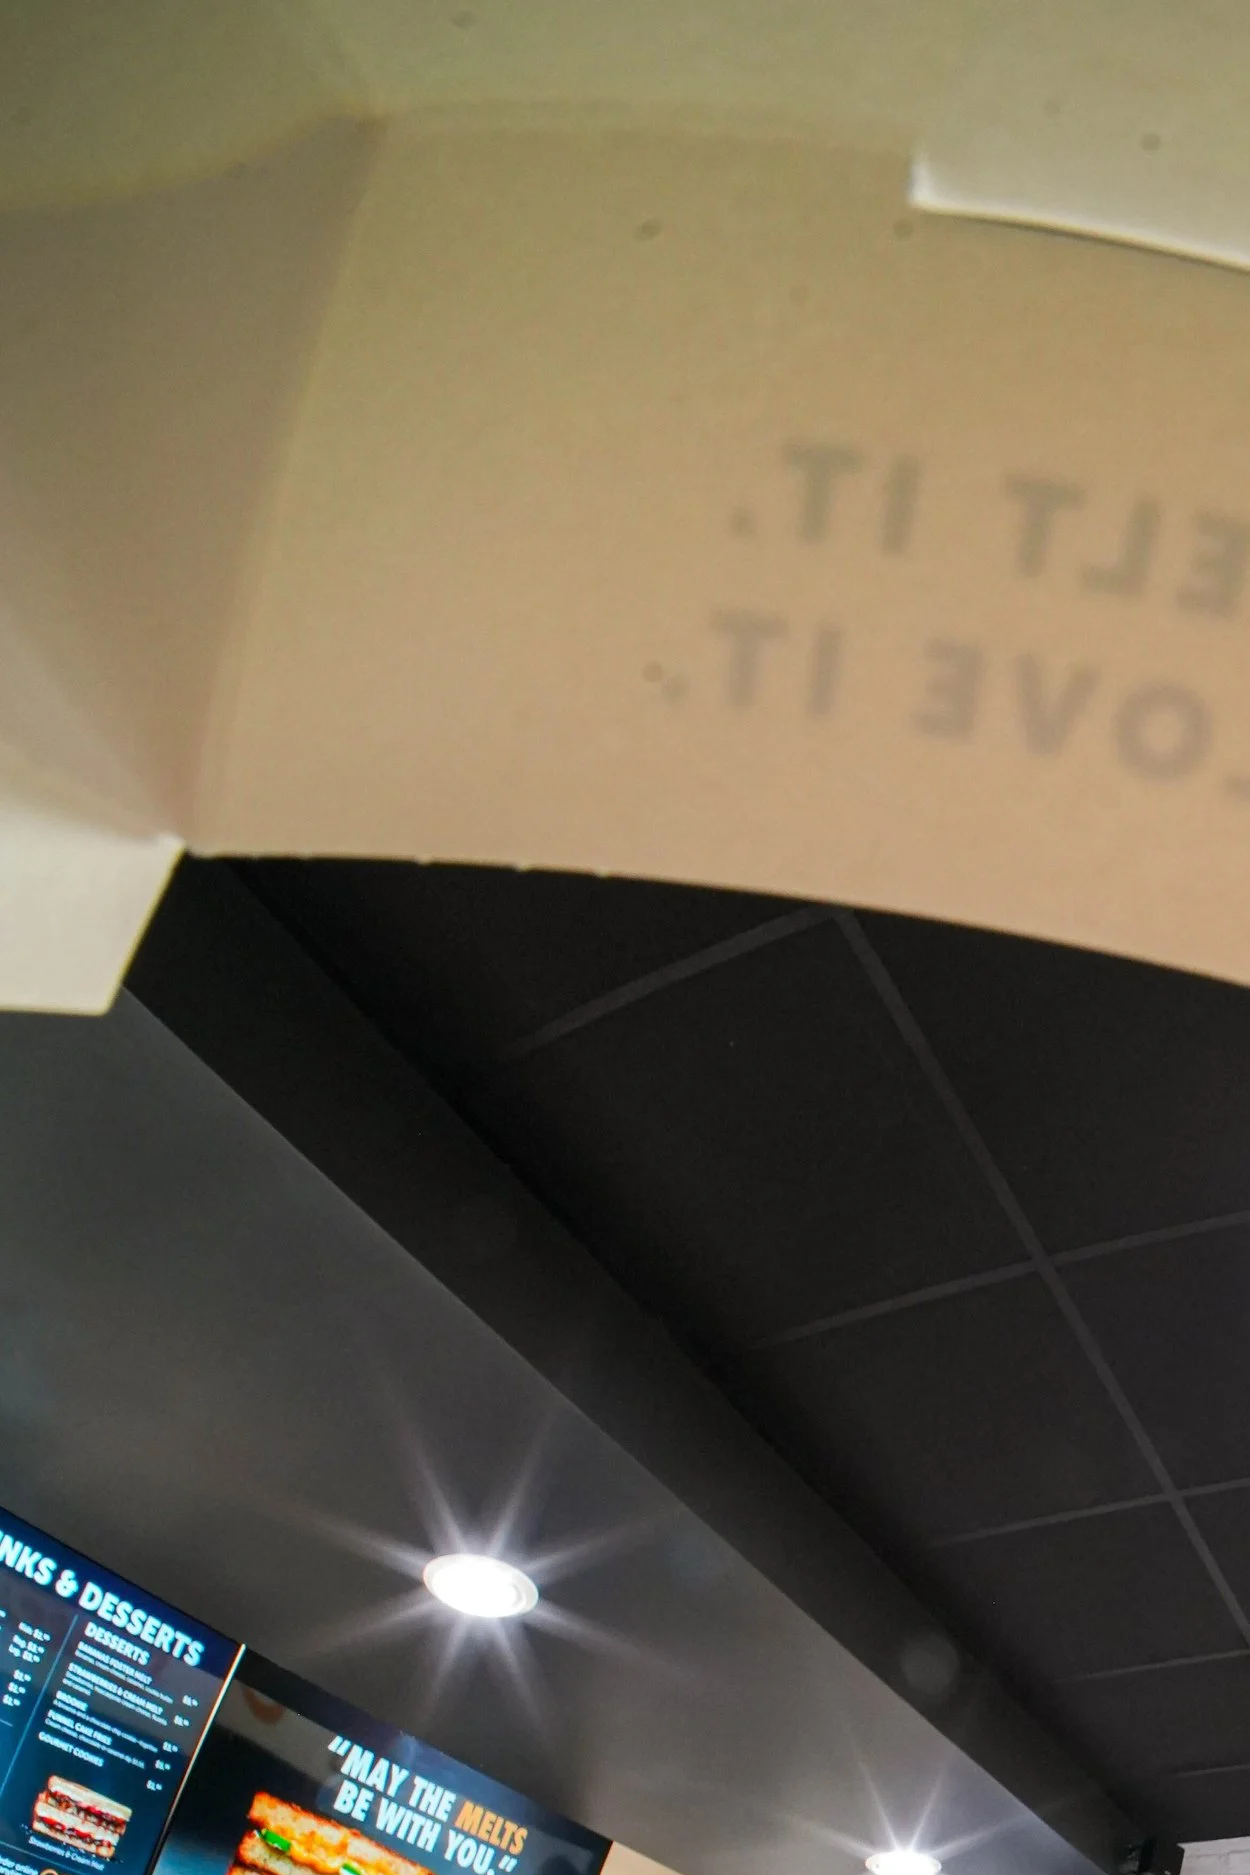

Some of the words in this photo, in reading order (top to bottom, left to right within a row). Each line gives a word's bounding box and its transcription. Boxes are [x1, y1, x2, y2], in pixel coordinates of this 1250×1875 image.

[0, 1530, 57, 1585] NKS
[55, 1569, 78, 1597] &
[79, 1582, 205, 1666] DESSERTS
[83, 1621, 150, 1665] DESSERTS
[75, 1722, 94, 1736] CAKE
[333, 1779, 374, 1822] BE
[376, 1797, 441, 1852] WITH
[408, 1775, 456, 1822] THE
[454, 1800, 528, 1855] MELTS
